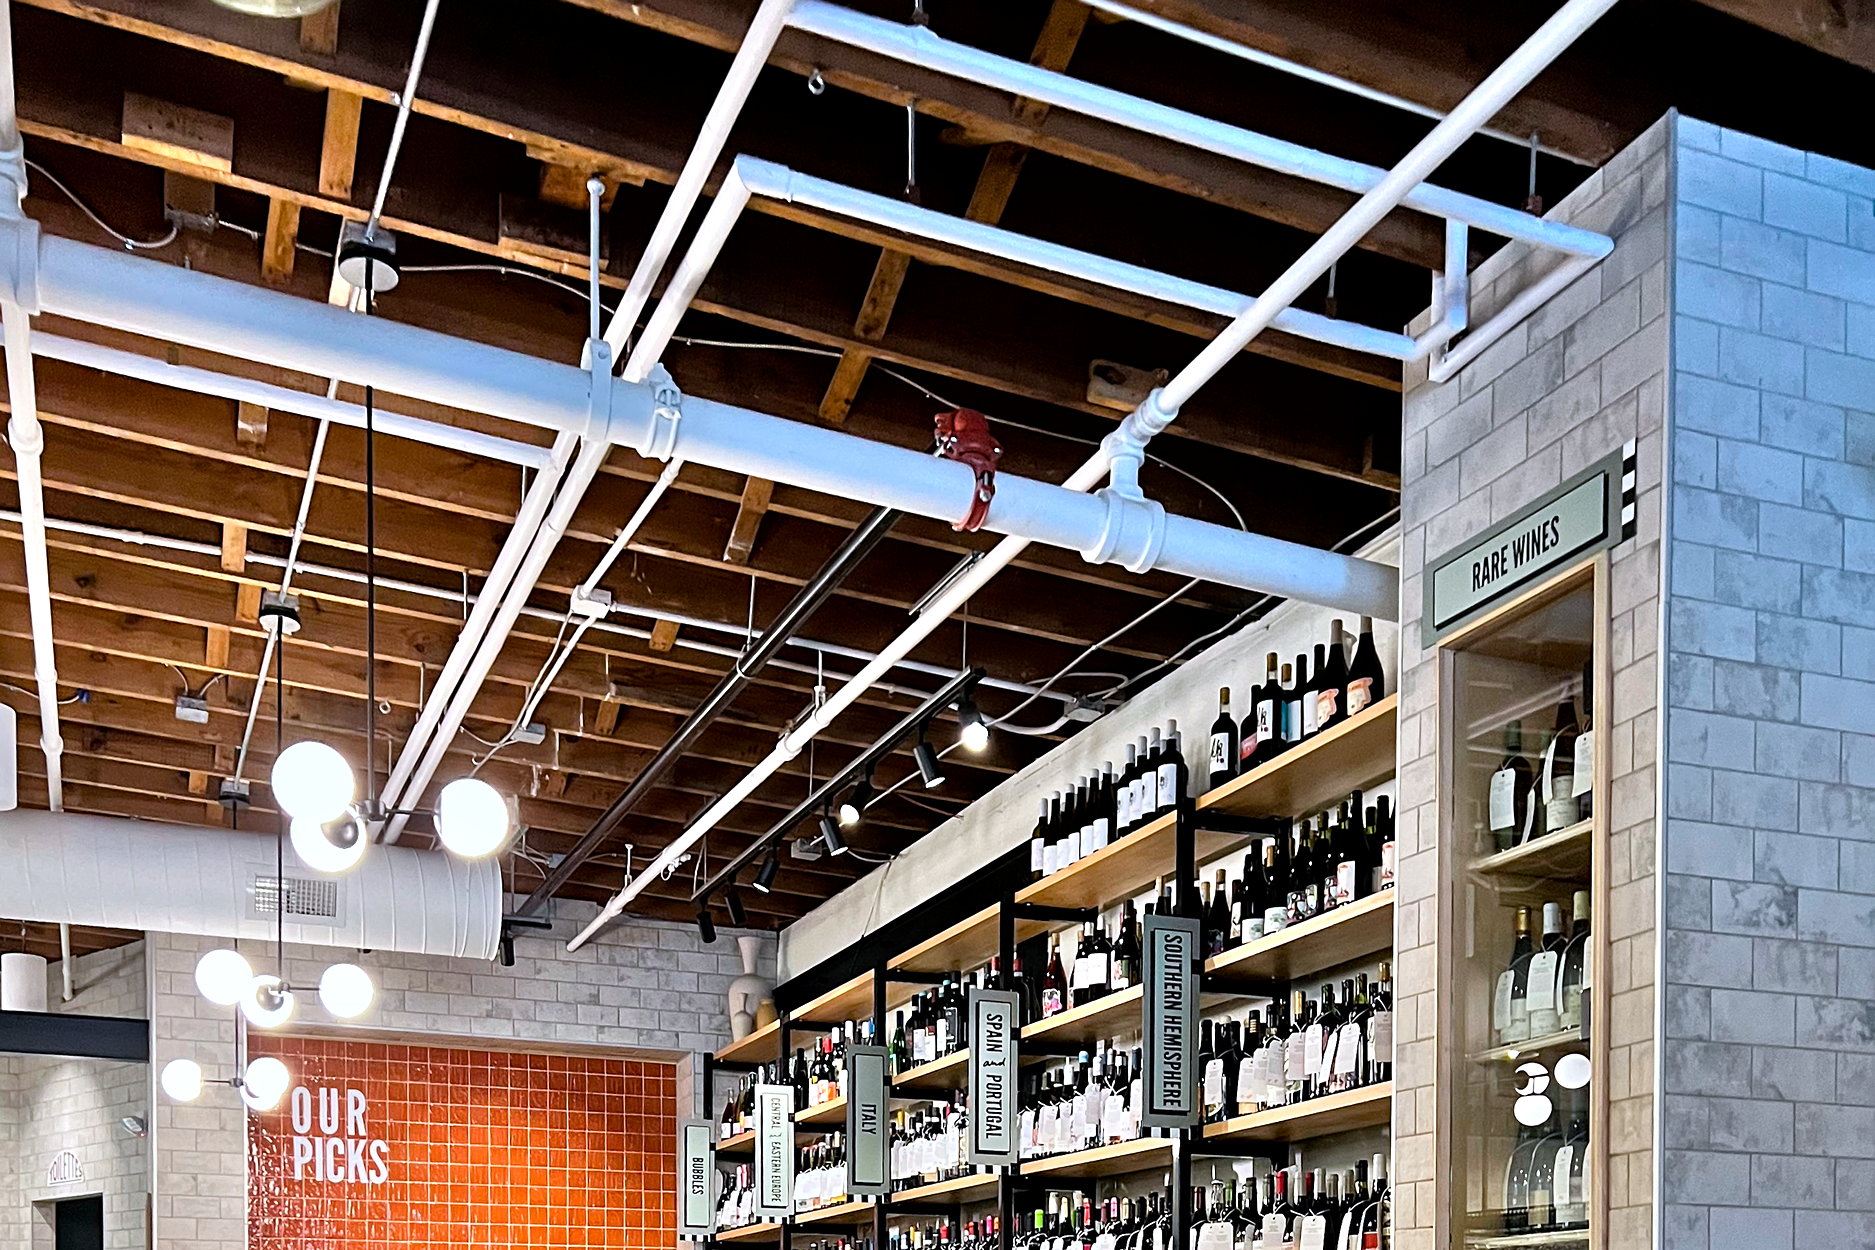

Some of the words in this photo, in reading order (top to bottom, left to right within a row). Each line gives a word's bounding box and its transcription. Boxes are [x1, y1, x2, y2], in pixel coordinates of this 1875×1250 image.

[1472, 544, 1508, 592] RARE
[1512, 515, 1560, 569] WINES
[1163, 933, 1183, 1011] SOUTHERN
[986, 1013, 1003, 1053] SPAIN
[983, 1057, 1006, 1068] and
[1162, 1014, 1183, 1108] HEMISPHERE
[291, 1086, 368, 1136] OUR
[770, 1097, 781, 1129] CENTRAL
[861, 1103, 877, 1135] ITALY
[985, 1073, 1003, 1139] PORTUGAL
[50, 1152, 82, 1182] TOILETTES
[293, 1136, 390, 1185] PICKS
[691, 1157, 704, 1195] BUBBLES
[770, 1141, 782, 1173] EASTERN
[770, 1175, 782, 1203] EUROPE
